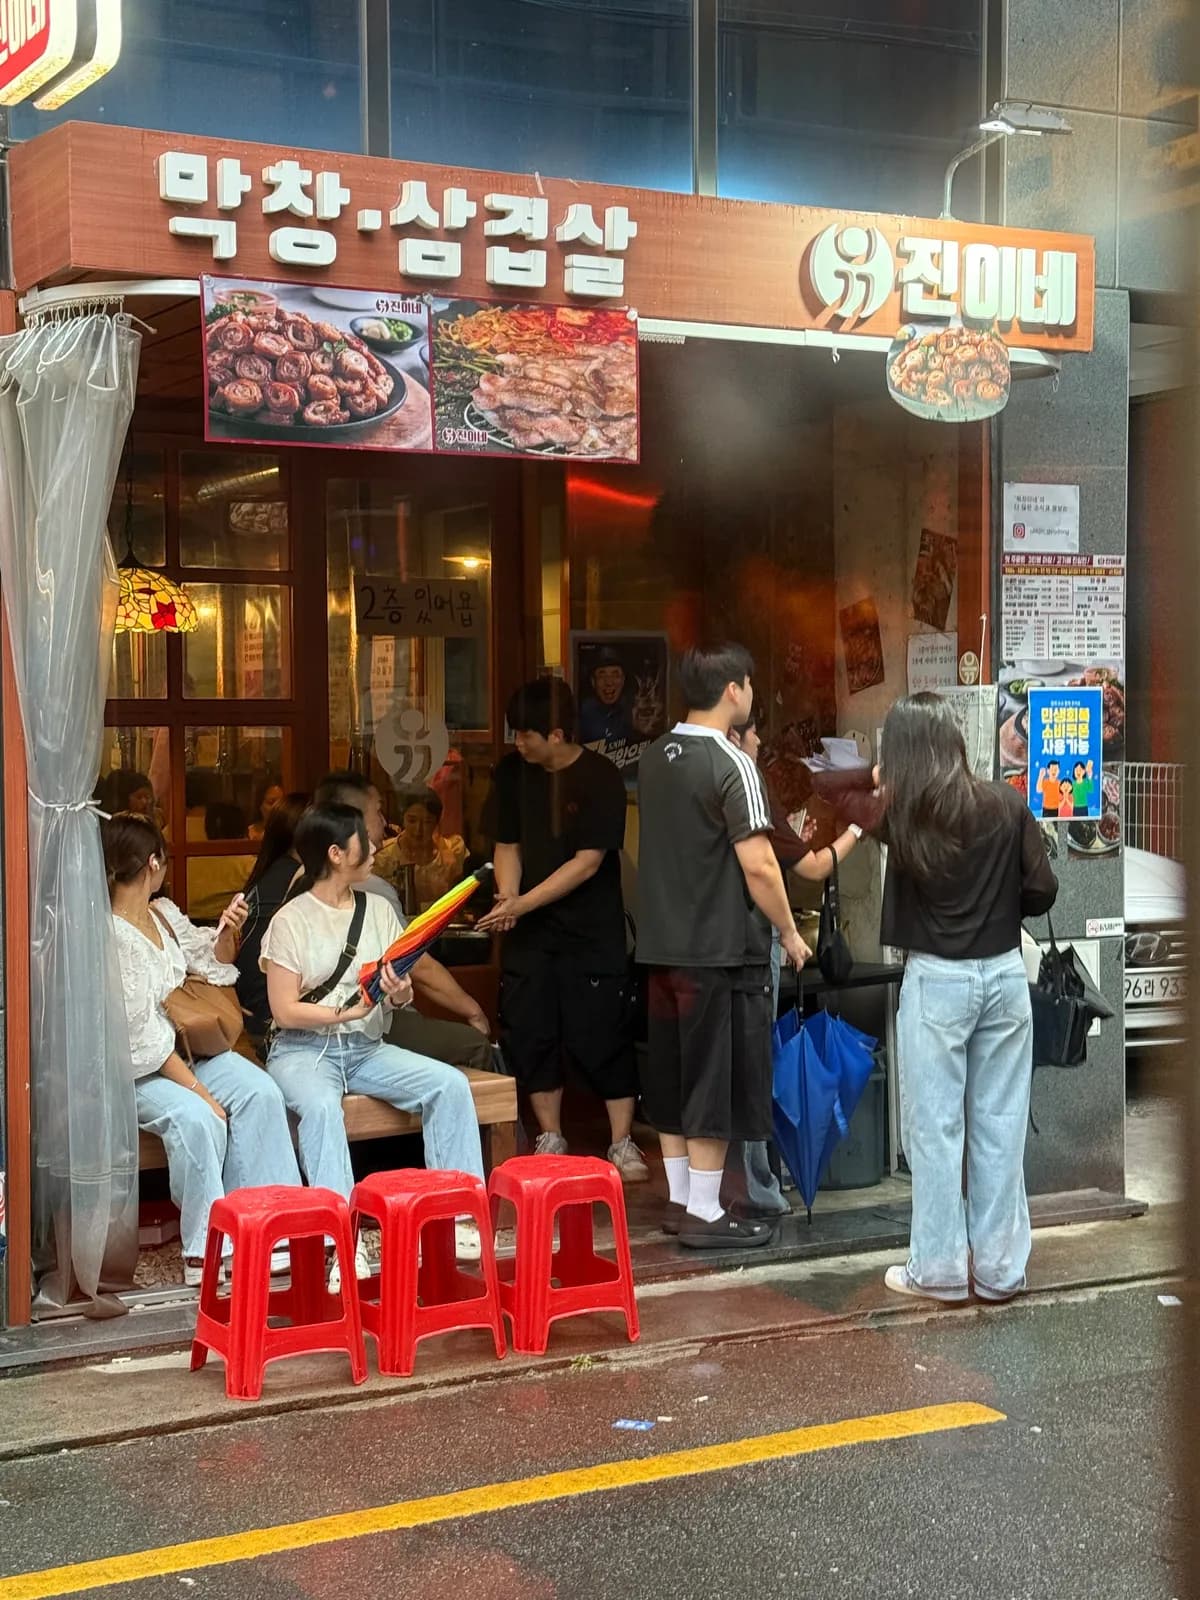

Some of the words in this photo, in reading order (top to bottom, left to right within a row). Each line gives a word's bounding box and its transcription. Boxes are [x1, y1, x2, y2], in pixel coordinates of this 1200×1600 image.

[899, 236, 1078, 327] 진이네
[390, 299, 423, 315] 진이네
[457, 429, 488, 444] 진이네
[361, 584, 406, 624] 2층
[414, 583, 477, 628] 있어욥
